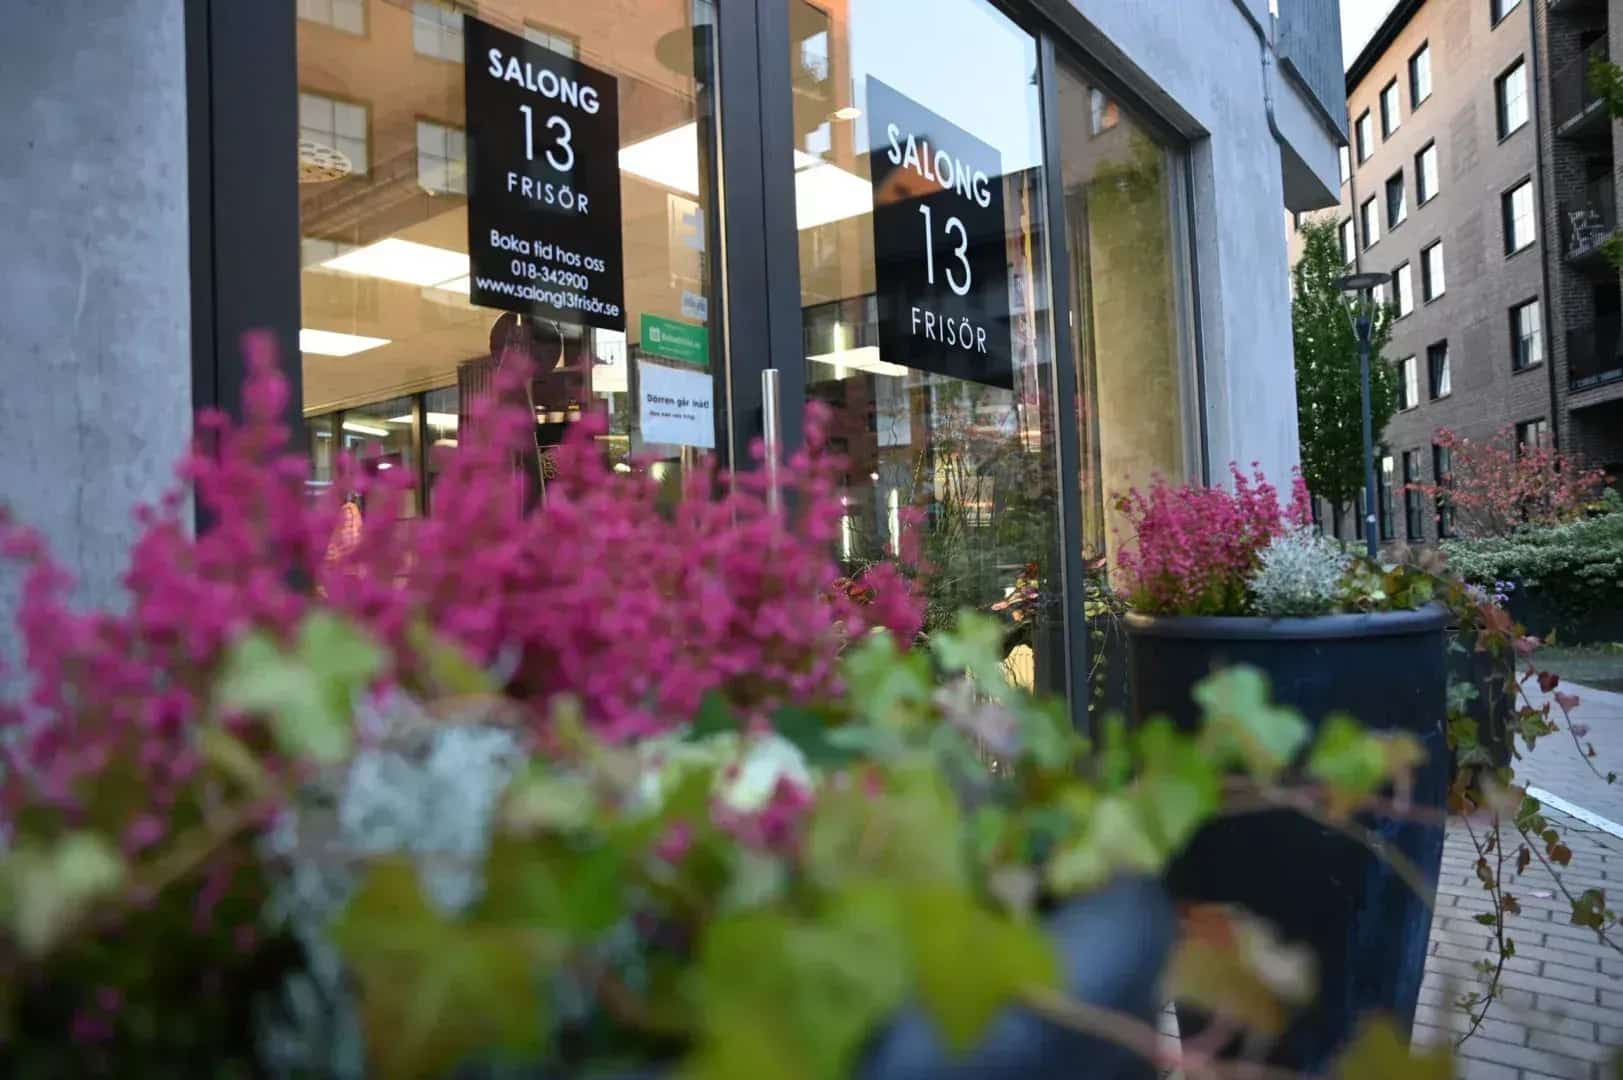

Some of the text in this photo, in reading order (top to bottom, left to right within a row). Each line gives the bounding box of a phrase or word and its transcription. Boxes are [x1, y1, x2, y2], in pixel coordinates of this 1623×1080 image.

[488, 48, 600, 114] SALONG
[519, 104, 575, 172] 13
[887, 123, 991, 208] SALONG
[507, 172, 589, 214] FRISÖR
[490, 229, 605, 272] Boka tid hos oss
[919, 203, 972, 296] 13
[476, 277, 619, 316] www.salong13frisör.se
[511, 259, 589, 290] 018-342900
[911, 306, 987, 354] FRISÖR
